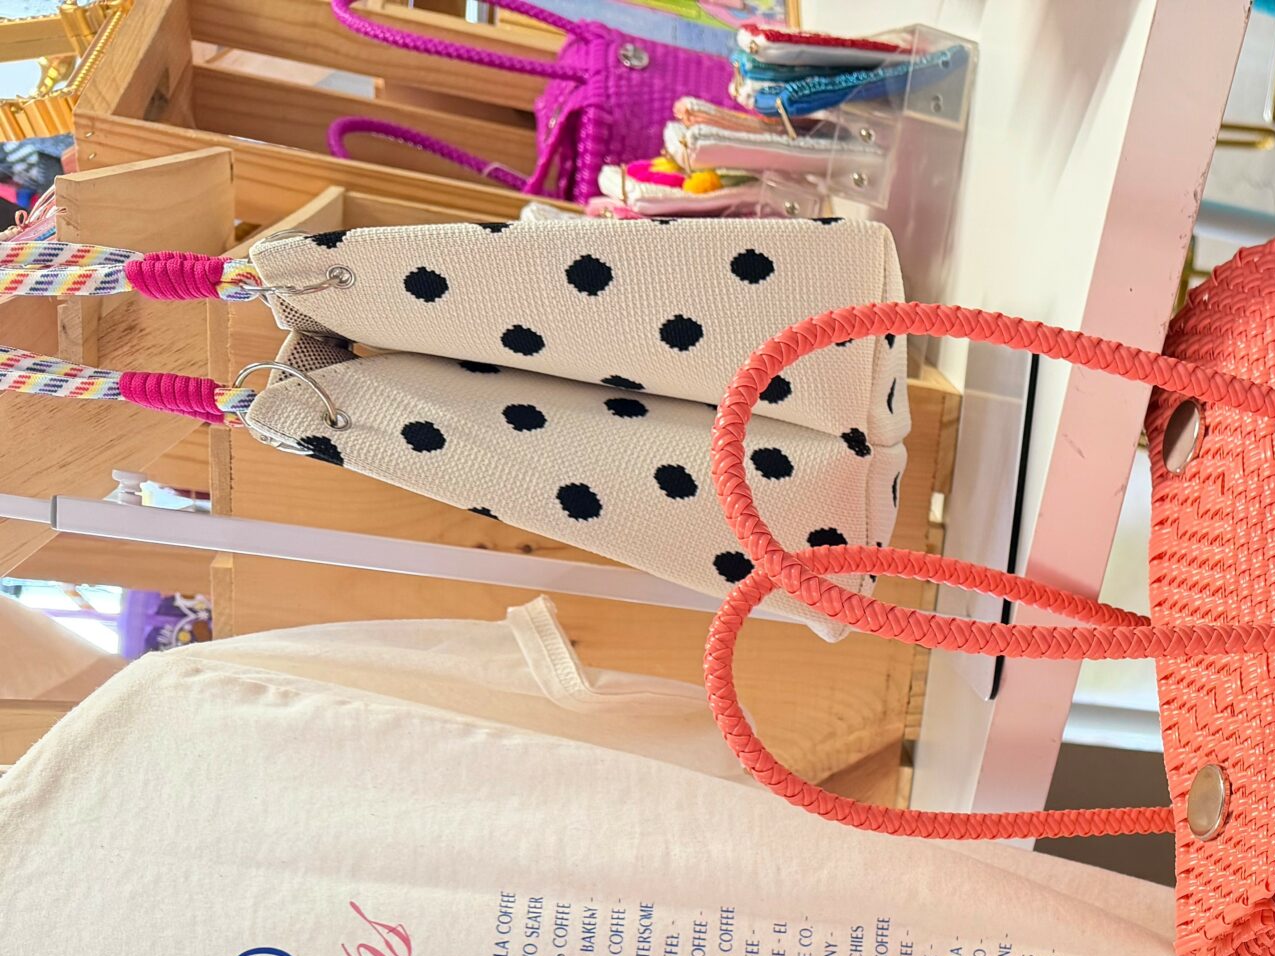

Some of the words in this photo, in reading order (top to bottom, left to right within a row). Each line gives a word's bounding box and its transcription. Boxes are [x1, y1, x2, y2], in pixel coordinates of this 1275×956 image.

[525, 897, 543, 938] SEATER
[608, 909, 626, 954] COFFEE
[718, 907, 734, 952] COFFEE
